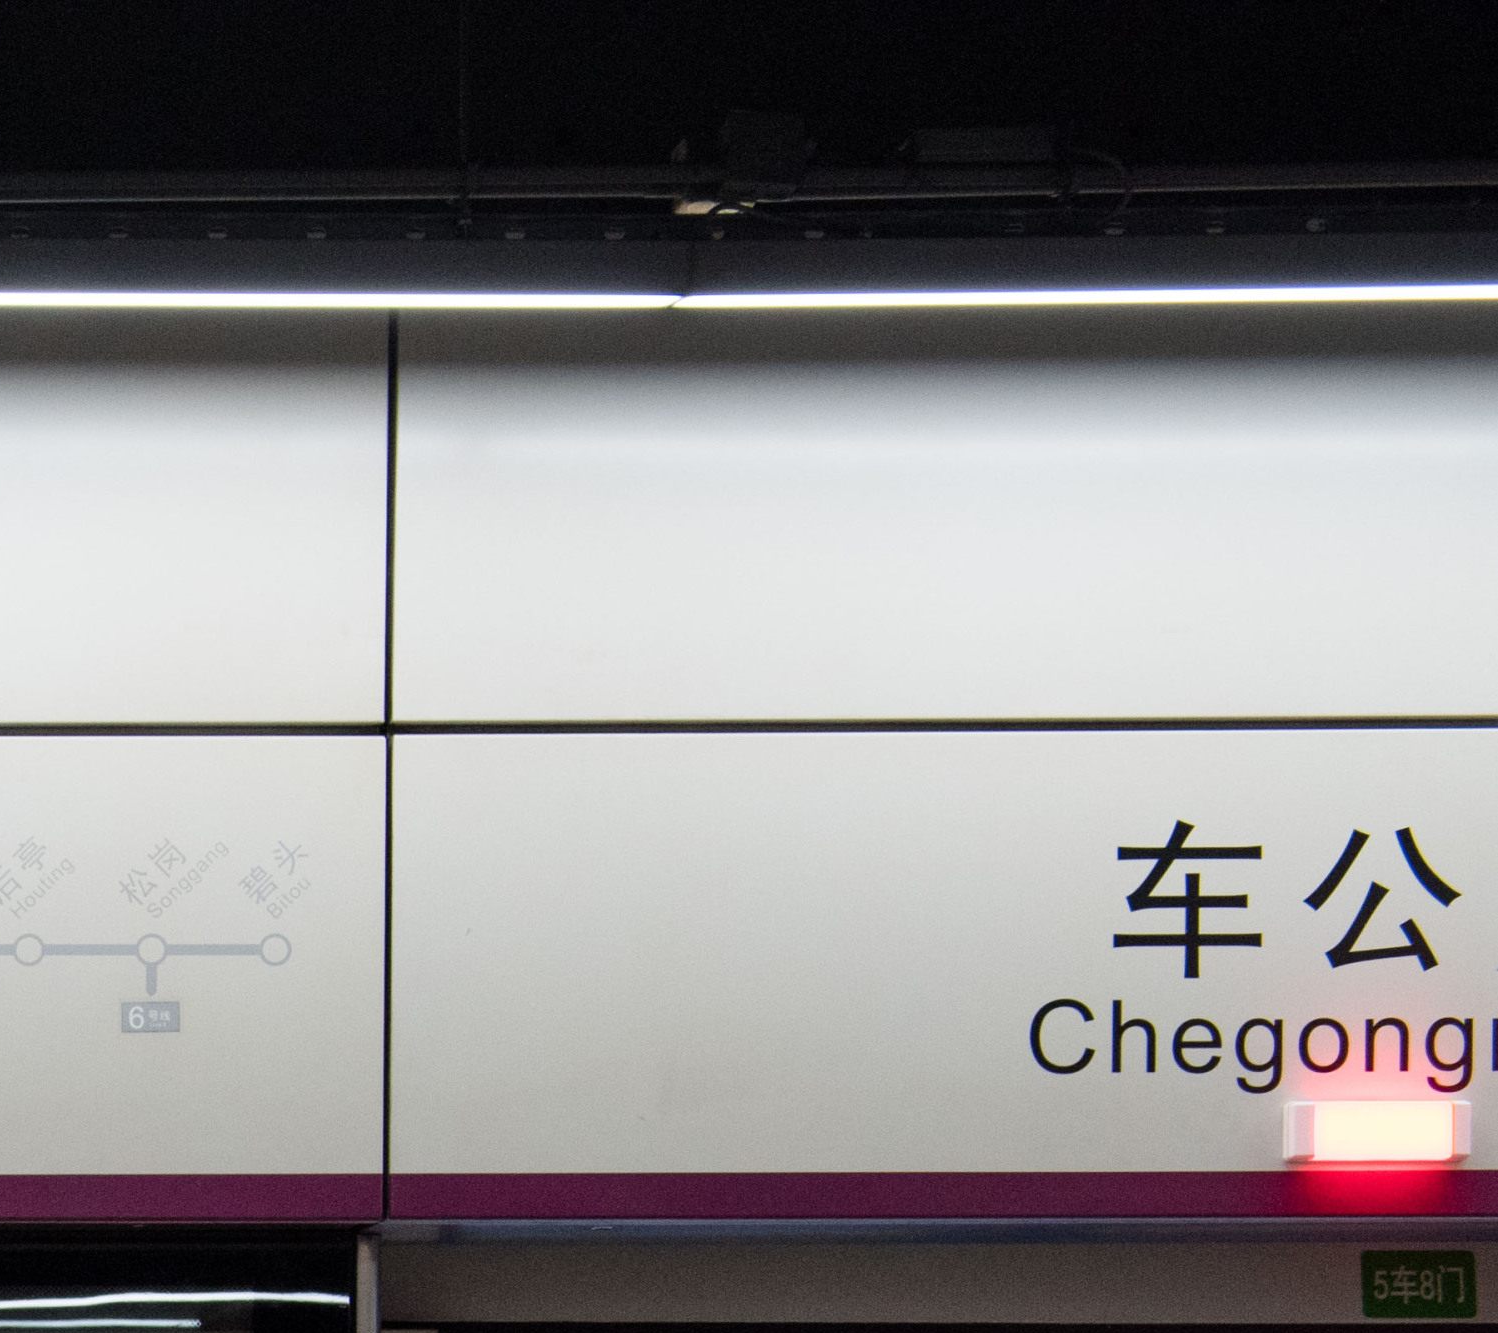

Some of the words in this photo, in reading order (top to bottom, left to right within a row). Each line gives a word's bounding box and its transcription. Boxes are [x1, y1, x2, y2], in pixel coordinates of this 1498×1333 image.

[9, 856, 77, 919] Houting
[117, 837, 187, 906] 松岗
[146, 839, 231, 919] Songgang
[238, 839, 310, 905] 碧头
[265, 876, 312, 920] Bitou
[1113, 820, 1498, 979] 车公
[1029, 998, 1498, 1095] Chegong
[1373, 1264, 1466, 1305] 5车8门
